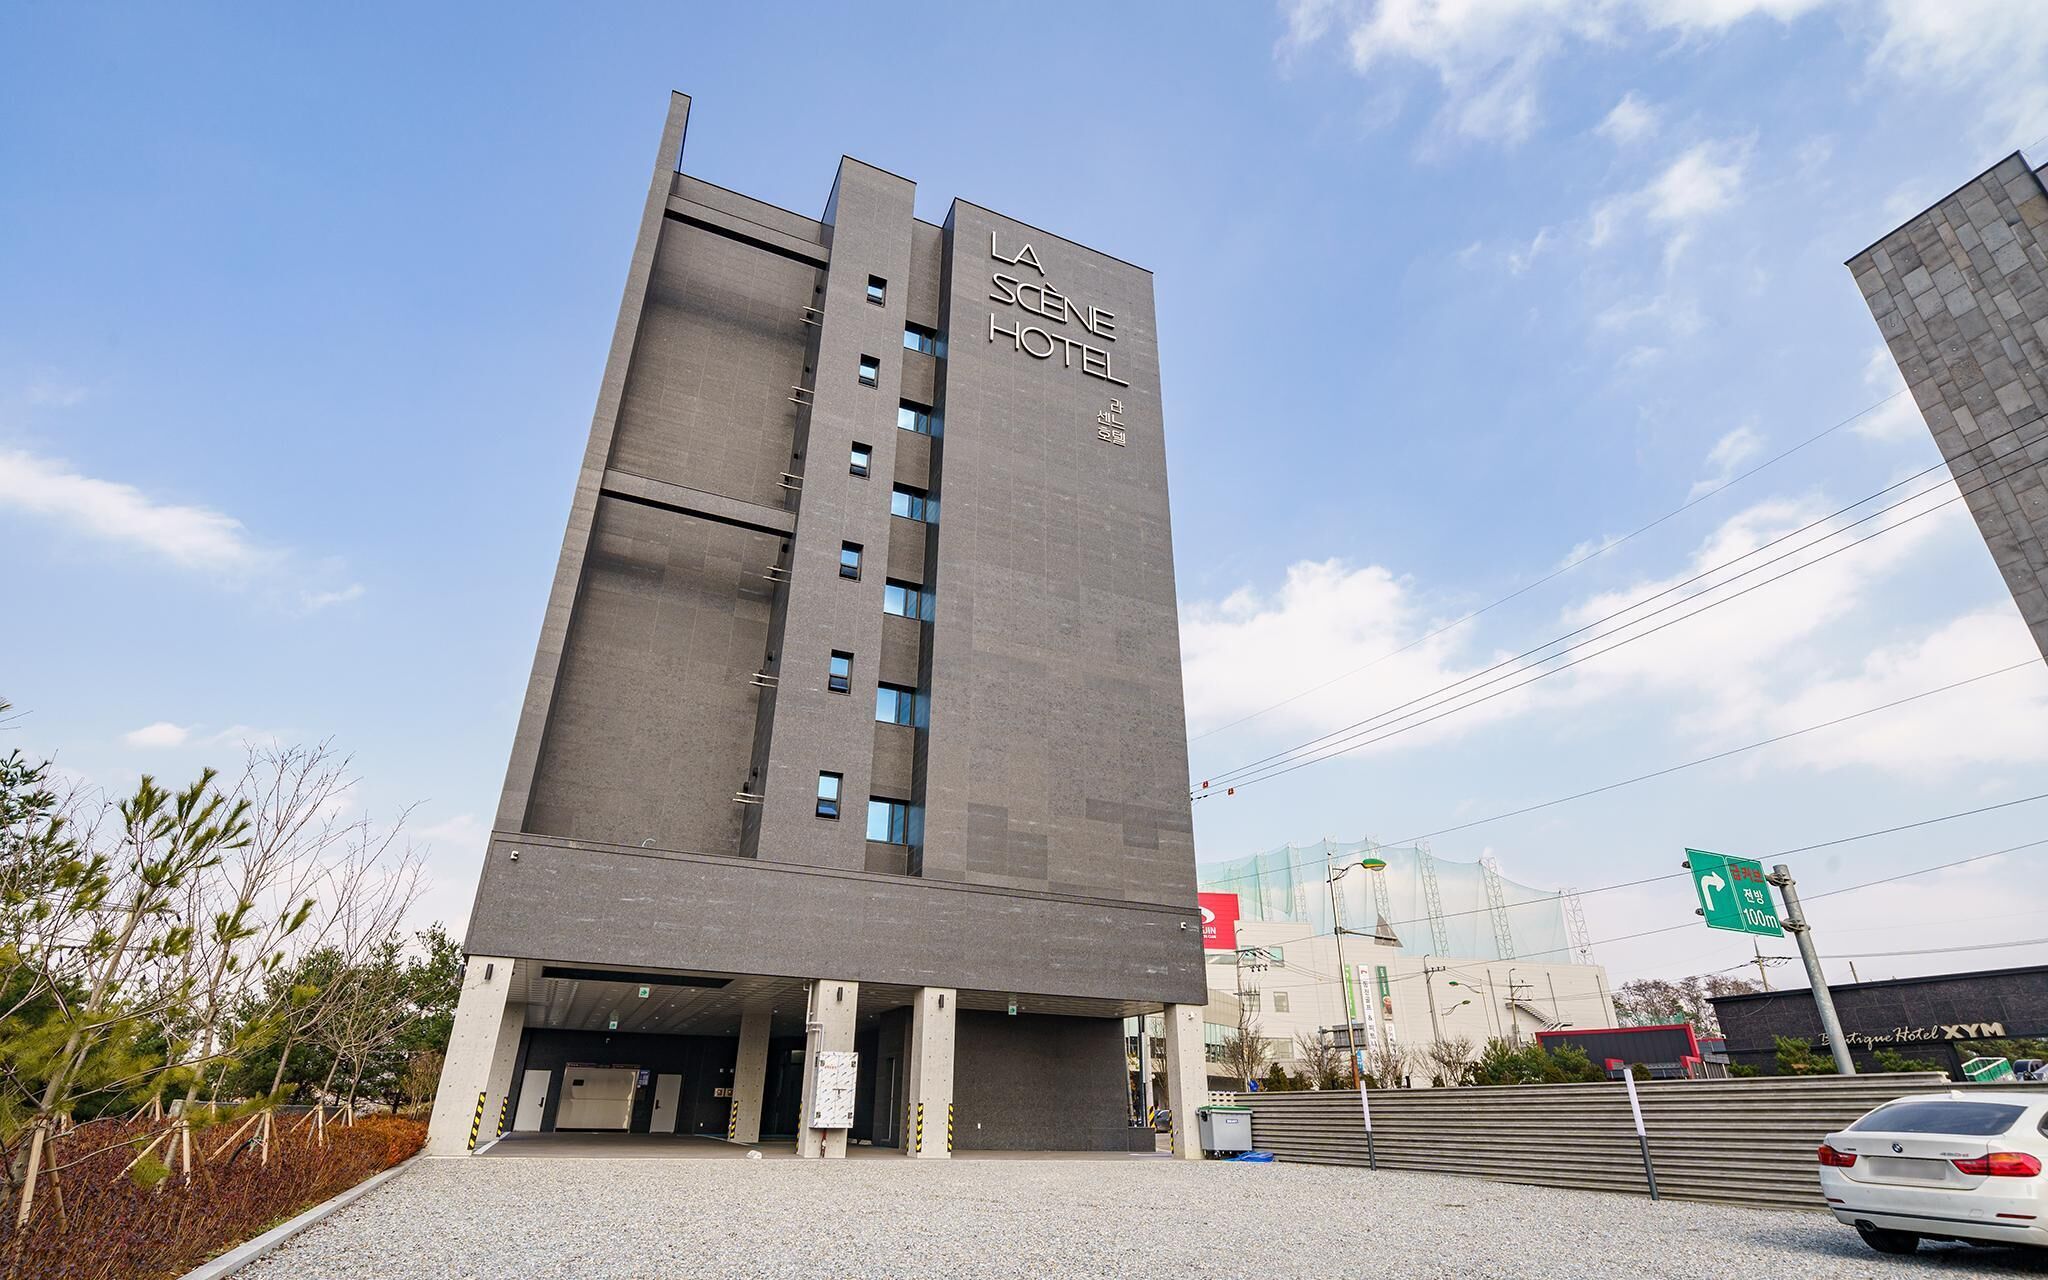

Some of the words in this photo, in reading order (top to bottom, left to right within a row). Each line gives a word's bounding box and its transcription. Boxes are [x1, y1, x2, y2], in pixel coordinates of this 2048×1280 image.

[991, 230, 1045, 276] LA
[989, 272, 1116, 341] SCÈNE
[989, 312, 1130, 388] HOTEL
[1110, 397, 1124, 415] 라
[1097, 426, 1126, 447] 호텔
[1743, 888, 1765, 905] 전방
[1743, 908, 1779, 929] 100m
[1818, 1030, 1893, 1051] Btique
[1893, 1025, 1940, 1042] Hotel
[1940, 1021, 2007, 1040] XYM
